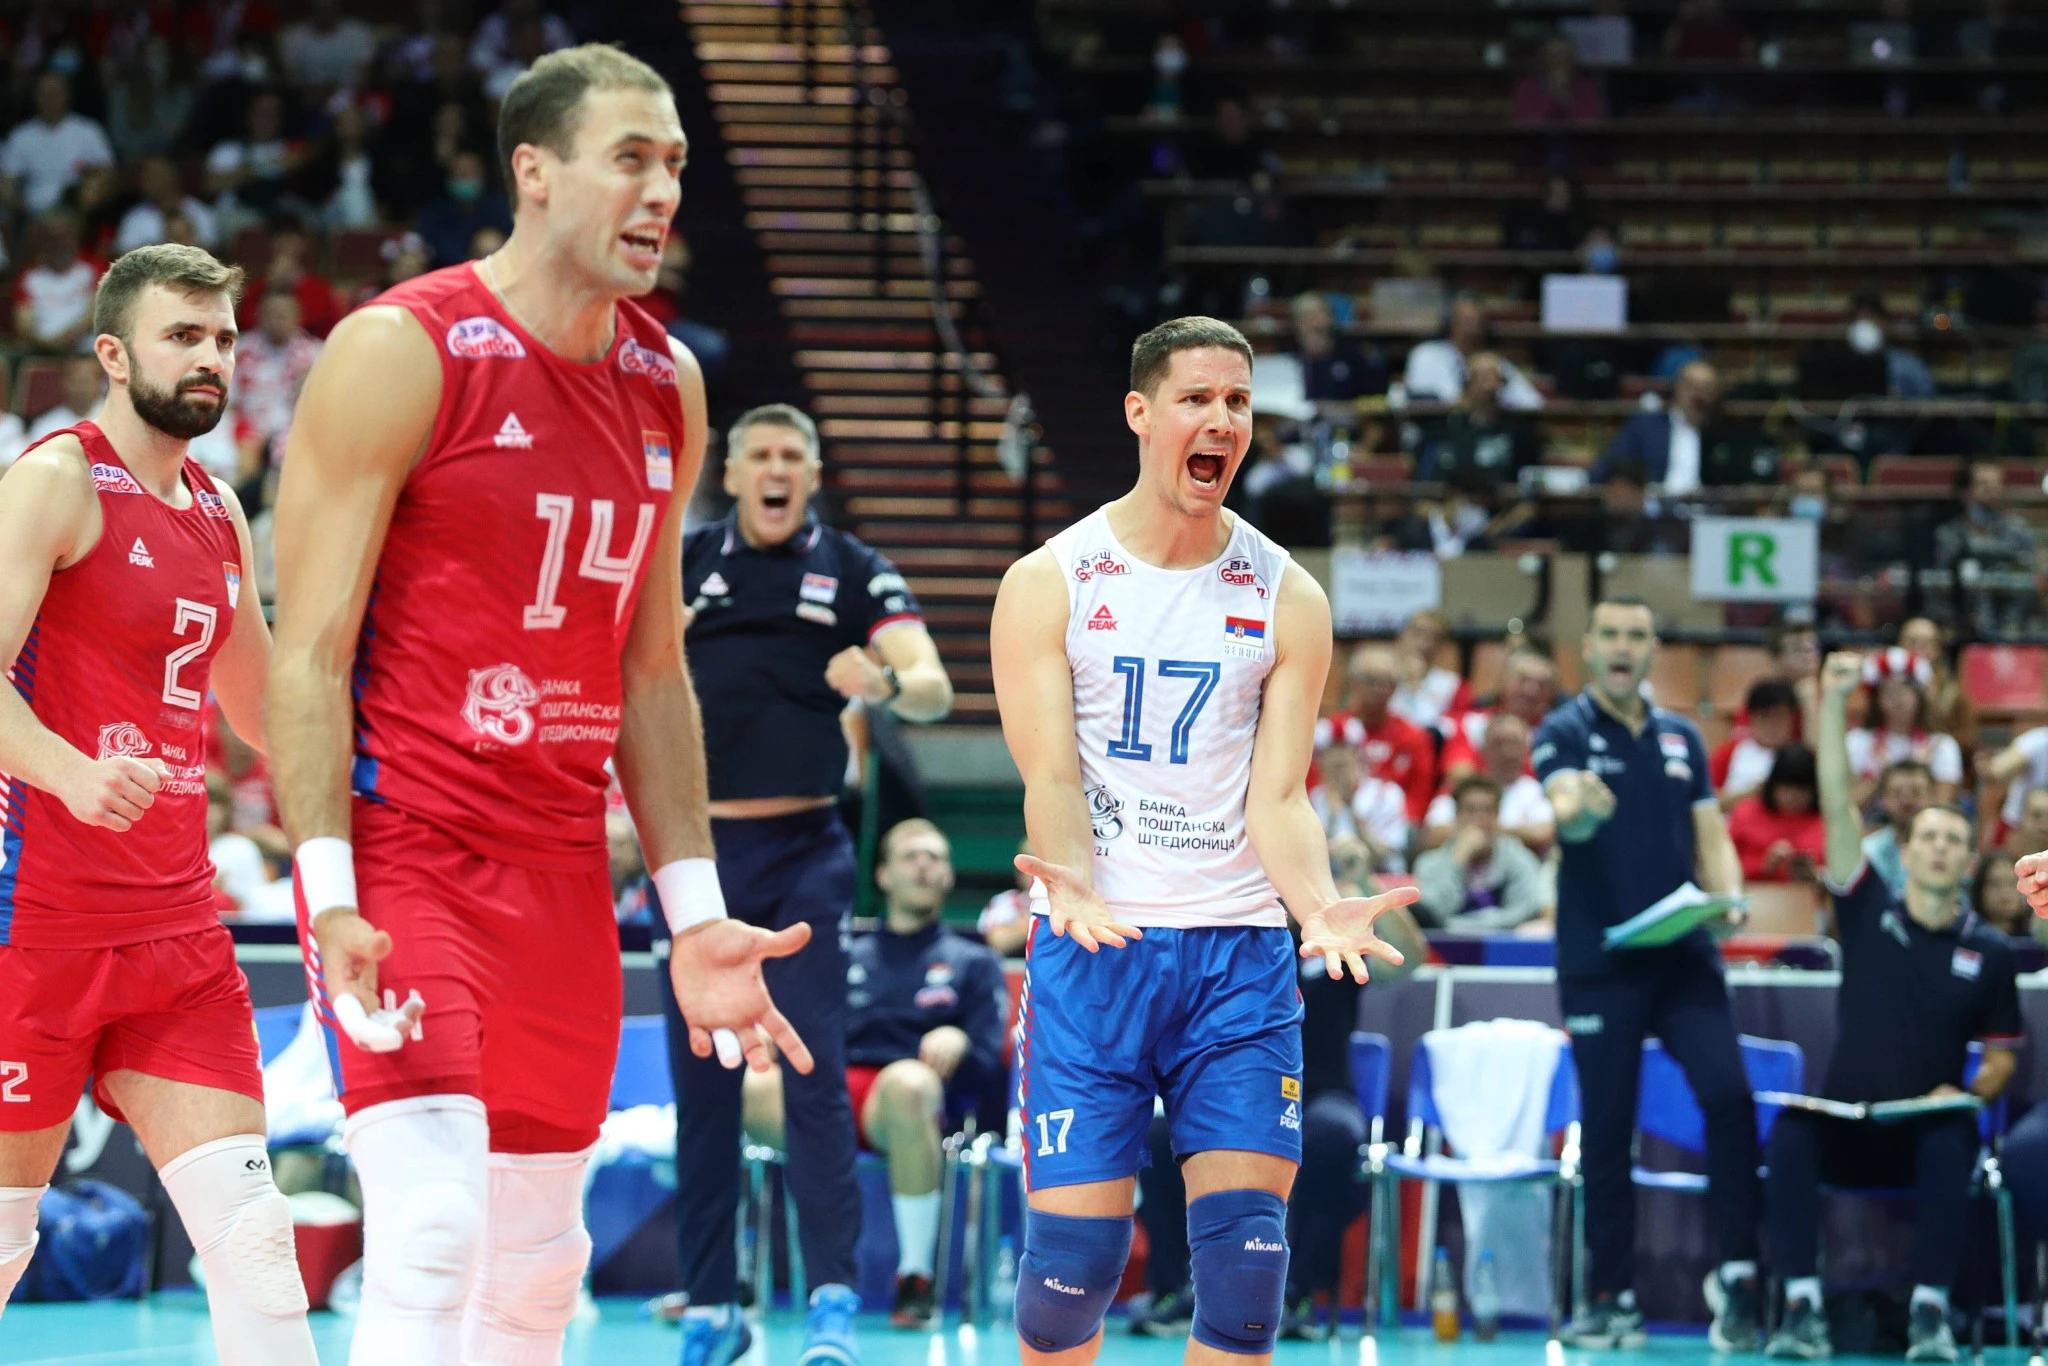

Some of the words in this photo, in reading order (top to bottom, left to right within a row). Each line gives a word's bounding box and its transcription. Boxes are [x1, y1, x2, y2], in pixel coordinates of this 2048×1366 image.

[128, 552, 155, 569] PEAK
[523, 492, 656, 632] 14
[1728, 532, 1780, 588] R
[1088, 620, 1119, 631] PEAK
[162, 597, 217, 711] 2
[1106, 655, 1221, 764] 17
[161, 743, 187, 761] БАНКА
[1139, 799, 1187, 818] БАНКА
[1138, 816, 1226, 833] ПОШТАНСКА
[1138, 833, 1236, 852] ШТЕДИОНИЦА
[0, 1060, 32, 1103] 2
[1036, 1108, 1075, 1157] 17
